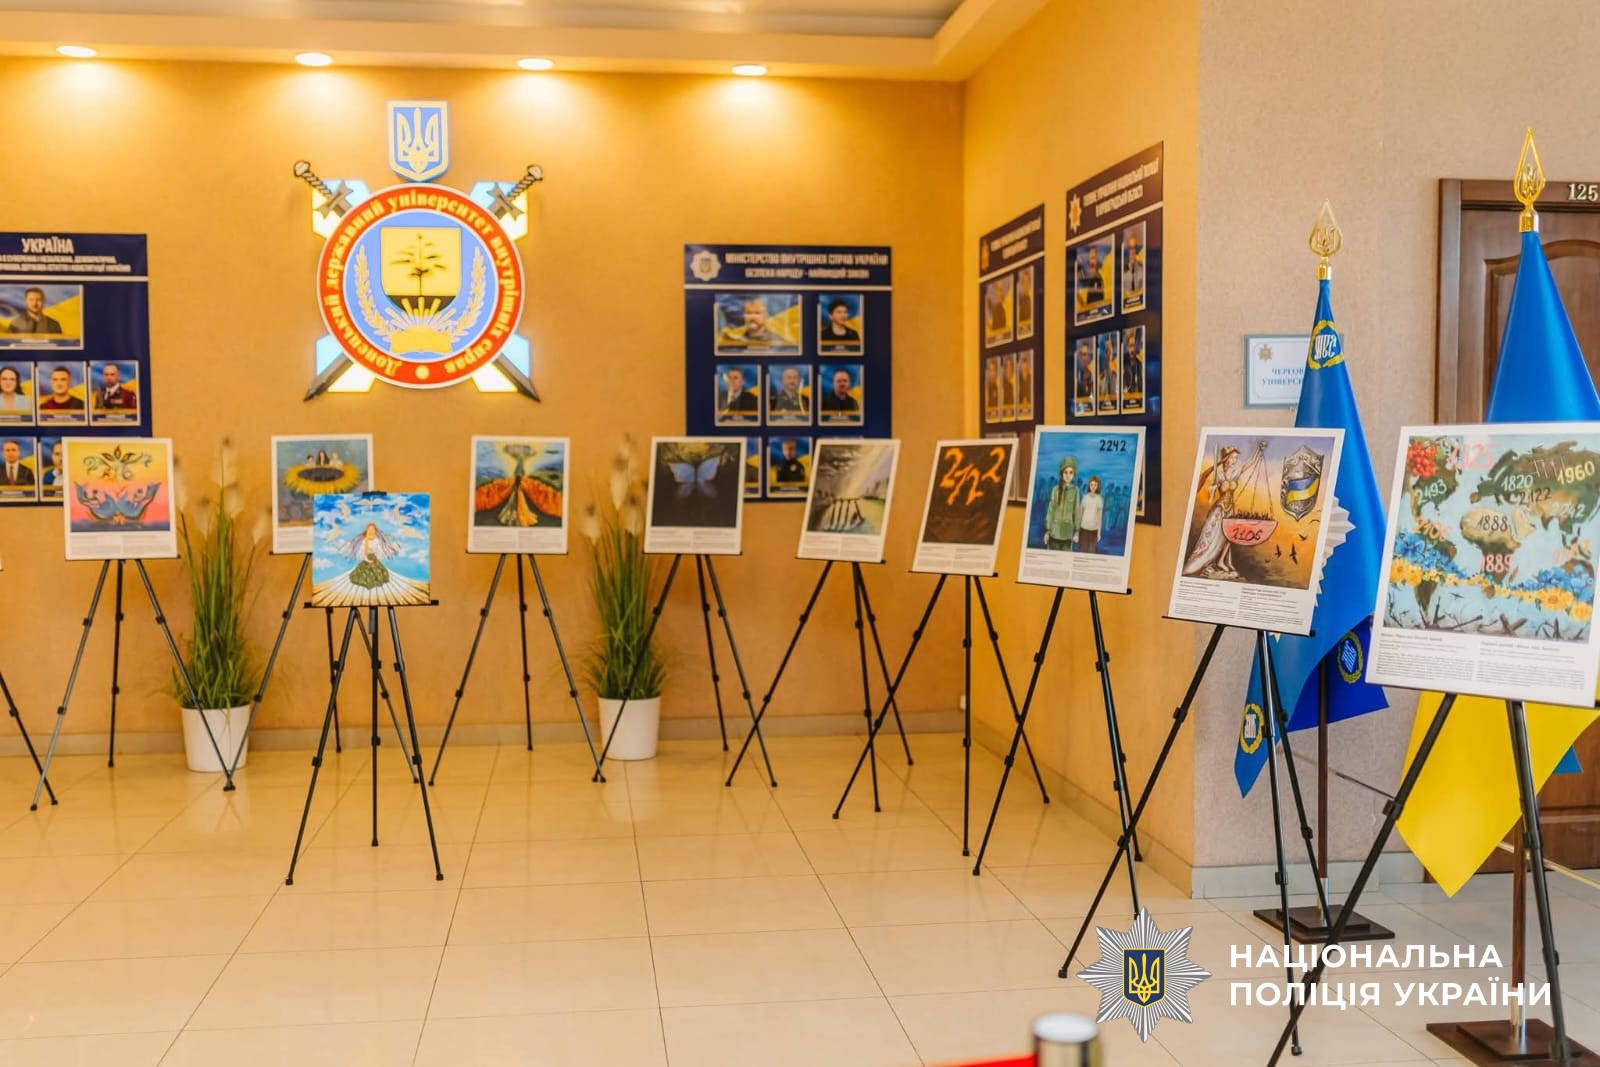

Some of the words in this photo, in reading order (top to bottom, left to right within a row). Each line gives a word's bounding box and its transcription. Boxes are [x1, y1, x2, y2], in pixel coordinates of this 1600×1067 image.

[1568, 183, 1599, 202] 125
[387, 190, 494, 235] університет
[21, 236, 75, 254] УКРАЇНА
[326, 198, 386, 291] державний
[324, 294, 403, 378] Донецький
[443, 341, 493, 374] справ
[1099, 438, 1128, 452] 2242
[1501, 473, 1534, 492] 1820
[1558, 460, 1595, 486] 1960
[1418, 479, 1448, 505] 2493
[1478, 514, 1509, 532] 1888
[1481, 553, 1514, 573] 1889
